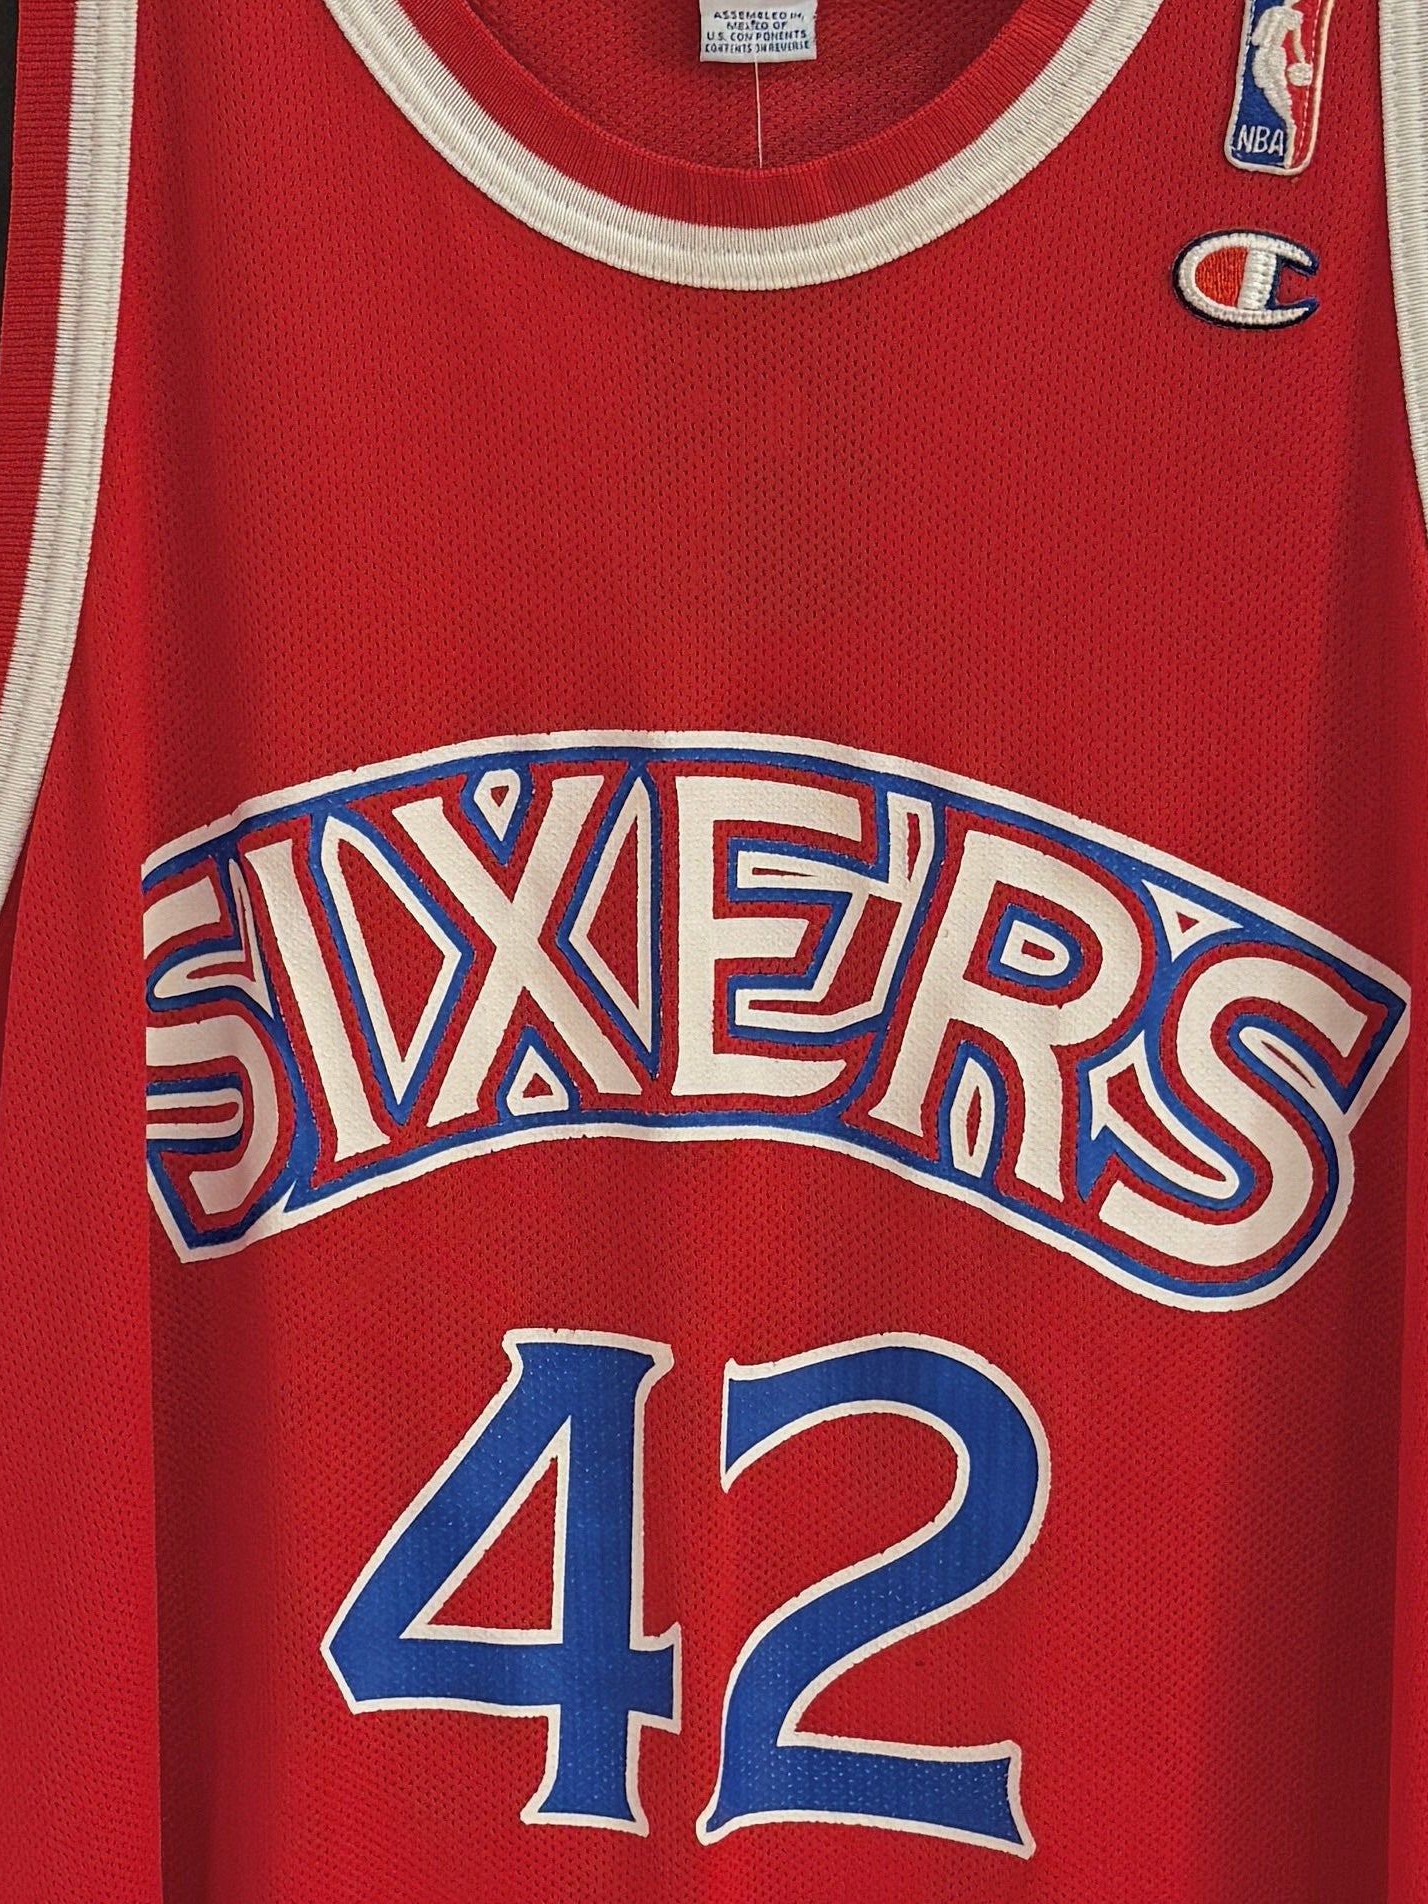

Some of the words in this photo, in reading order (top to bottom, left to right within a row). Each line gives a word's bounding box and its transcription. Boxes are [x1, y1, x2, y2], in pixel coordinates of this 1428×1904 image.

[730, 30, 807, 41] COMPONENTS
[773, 21, 788, 30] OF
[1235, 123, 1284, 156] NBA
[142, 730, 1410, 1312] SIXERS
[320, 1328, 1050, 1858] 42
